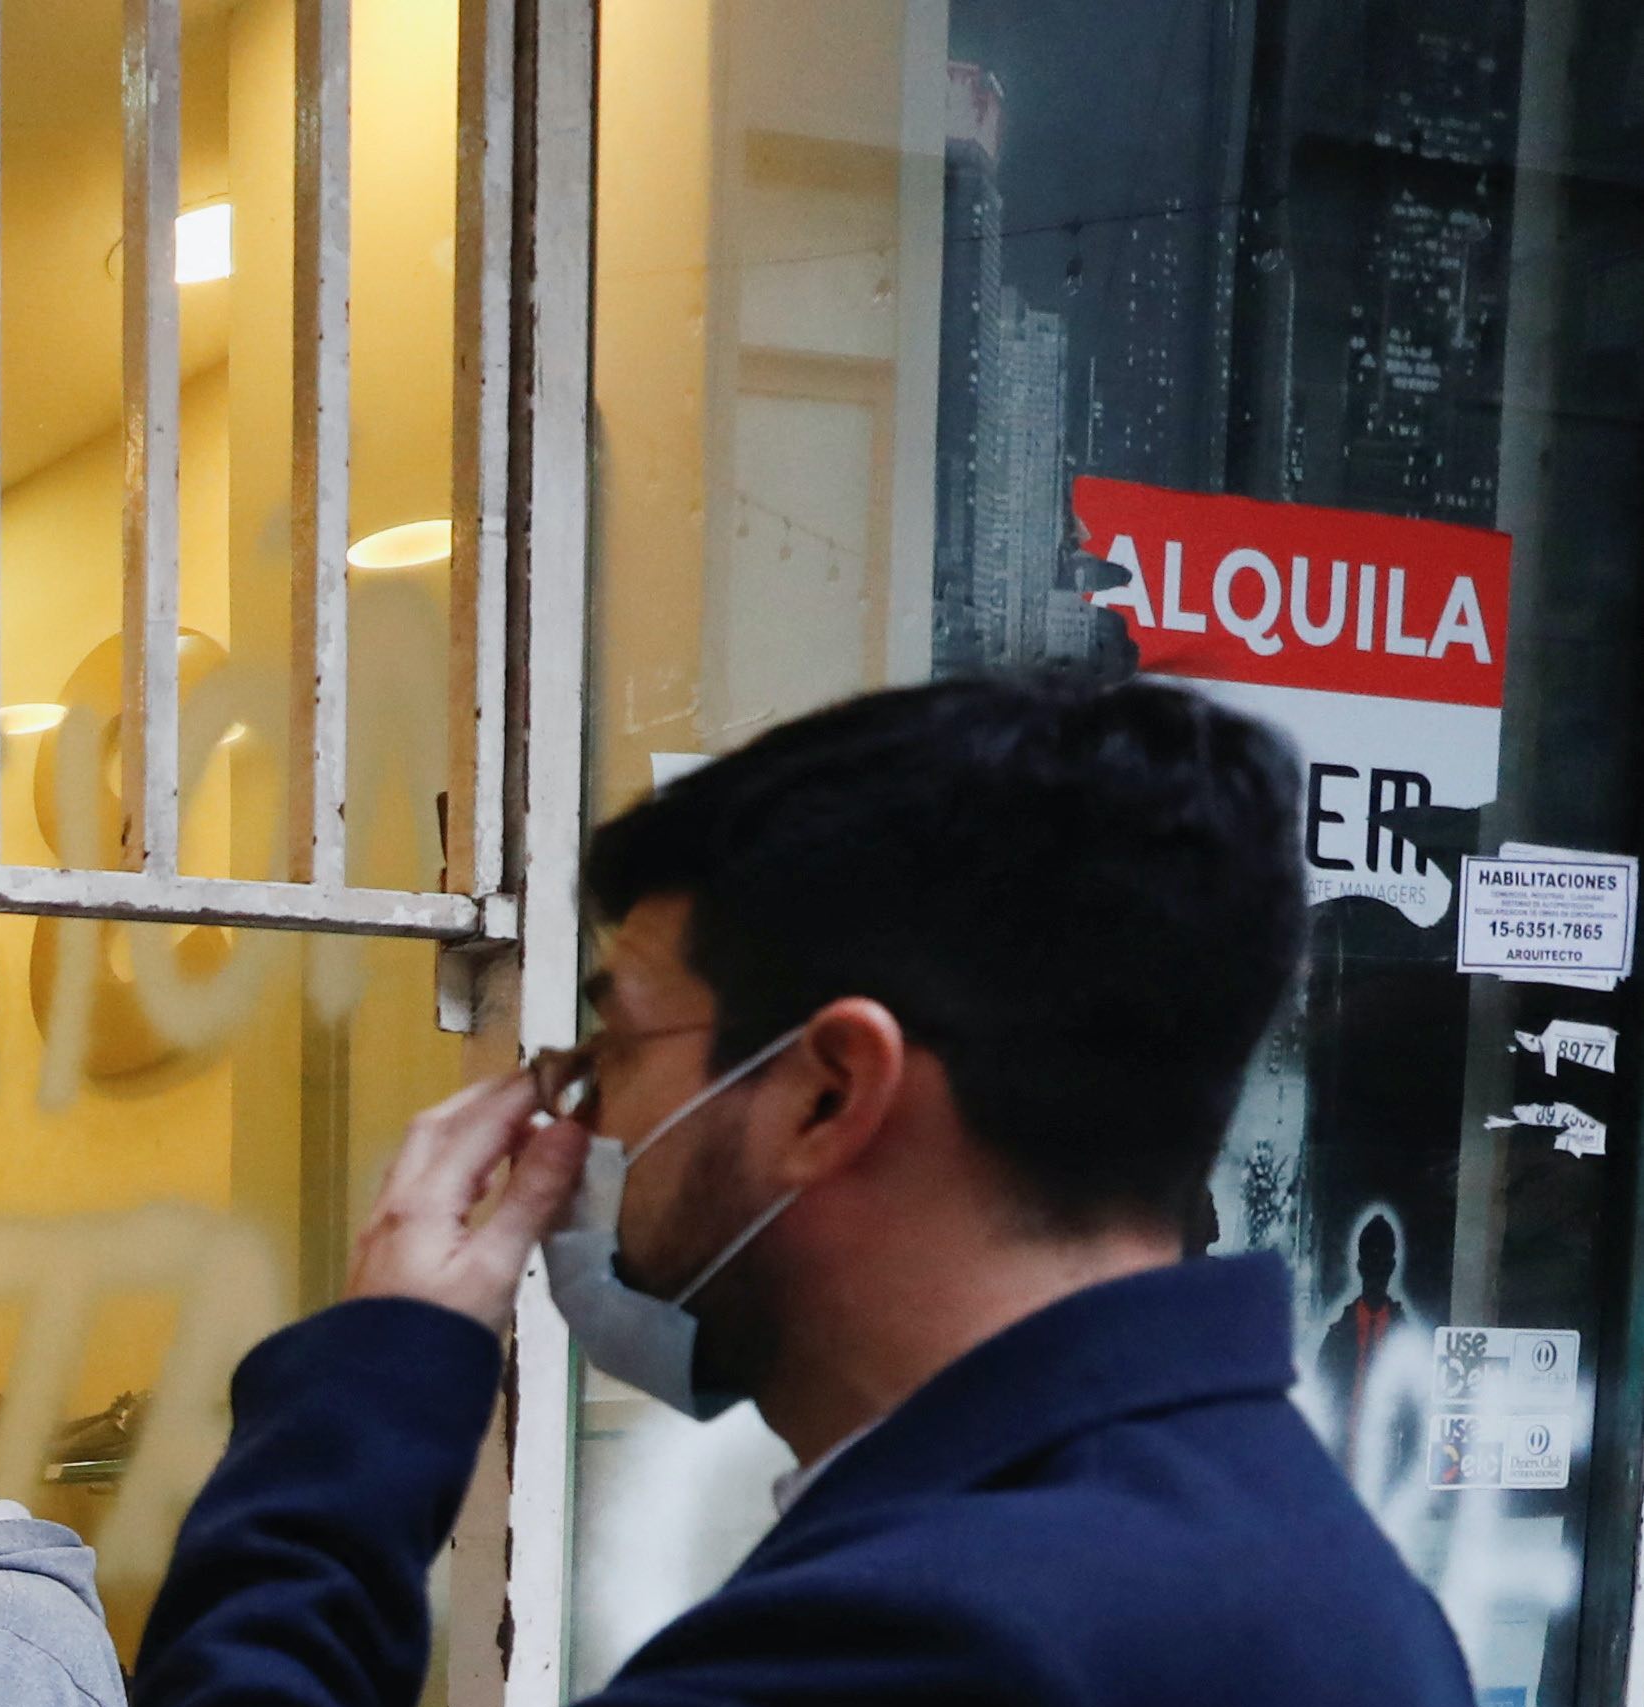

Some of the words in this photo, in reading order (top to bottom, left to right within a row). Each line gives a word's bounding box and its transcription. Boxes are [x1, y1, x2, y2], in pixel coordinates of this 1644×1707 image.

[1089, 534, 1492, 664] ALQUILA
[1479, 869, 1618, 891] HABILITACIONES
[1339, 881, 1427, 905] MANAGERS
[1489, 920, 1604, 941] 15-6351-7865
[1506, 949, 1583, 962] ARQUITECTO
